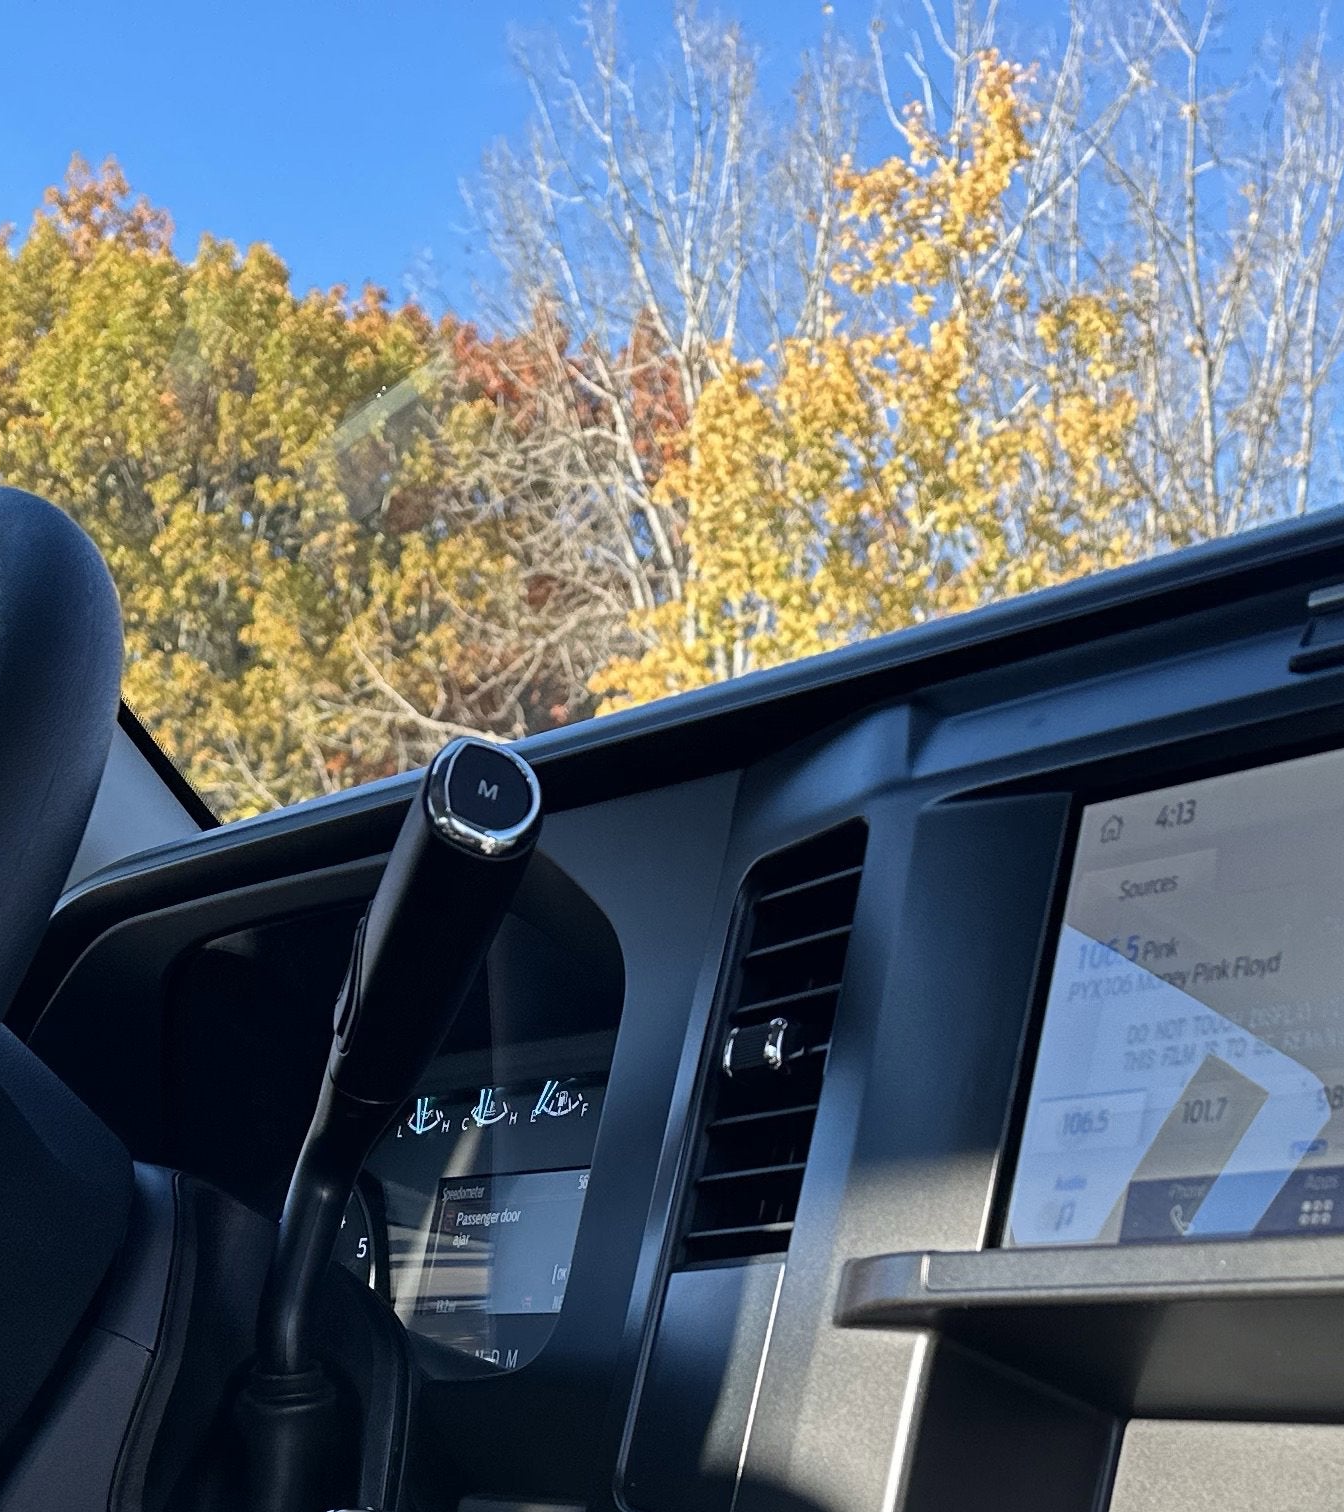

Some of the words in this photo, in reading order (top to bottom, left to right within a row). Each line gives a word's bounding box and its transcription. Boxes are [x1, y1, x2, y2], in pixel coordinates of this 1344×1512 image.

[478, 779, 499, 800] M
[1156, 799, 1197, 829] 4:13
[1118, 875, 1179, 900] Sources
[1192, 959, 1229, 984] Pink
[1232, 951, 1284, 979] Floyd
[1181, 1096, 1228, 1125] 101.7
[1062, 1110, 1110, 1137] 106.5
[442, 1185, 485, 1202] Speedometer
[456, 1210, 499, 1226] Passenger
[500, 1208, 521, 1224] door
[452, 1232, 470, 1249] ajar
